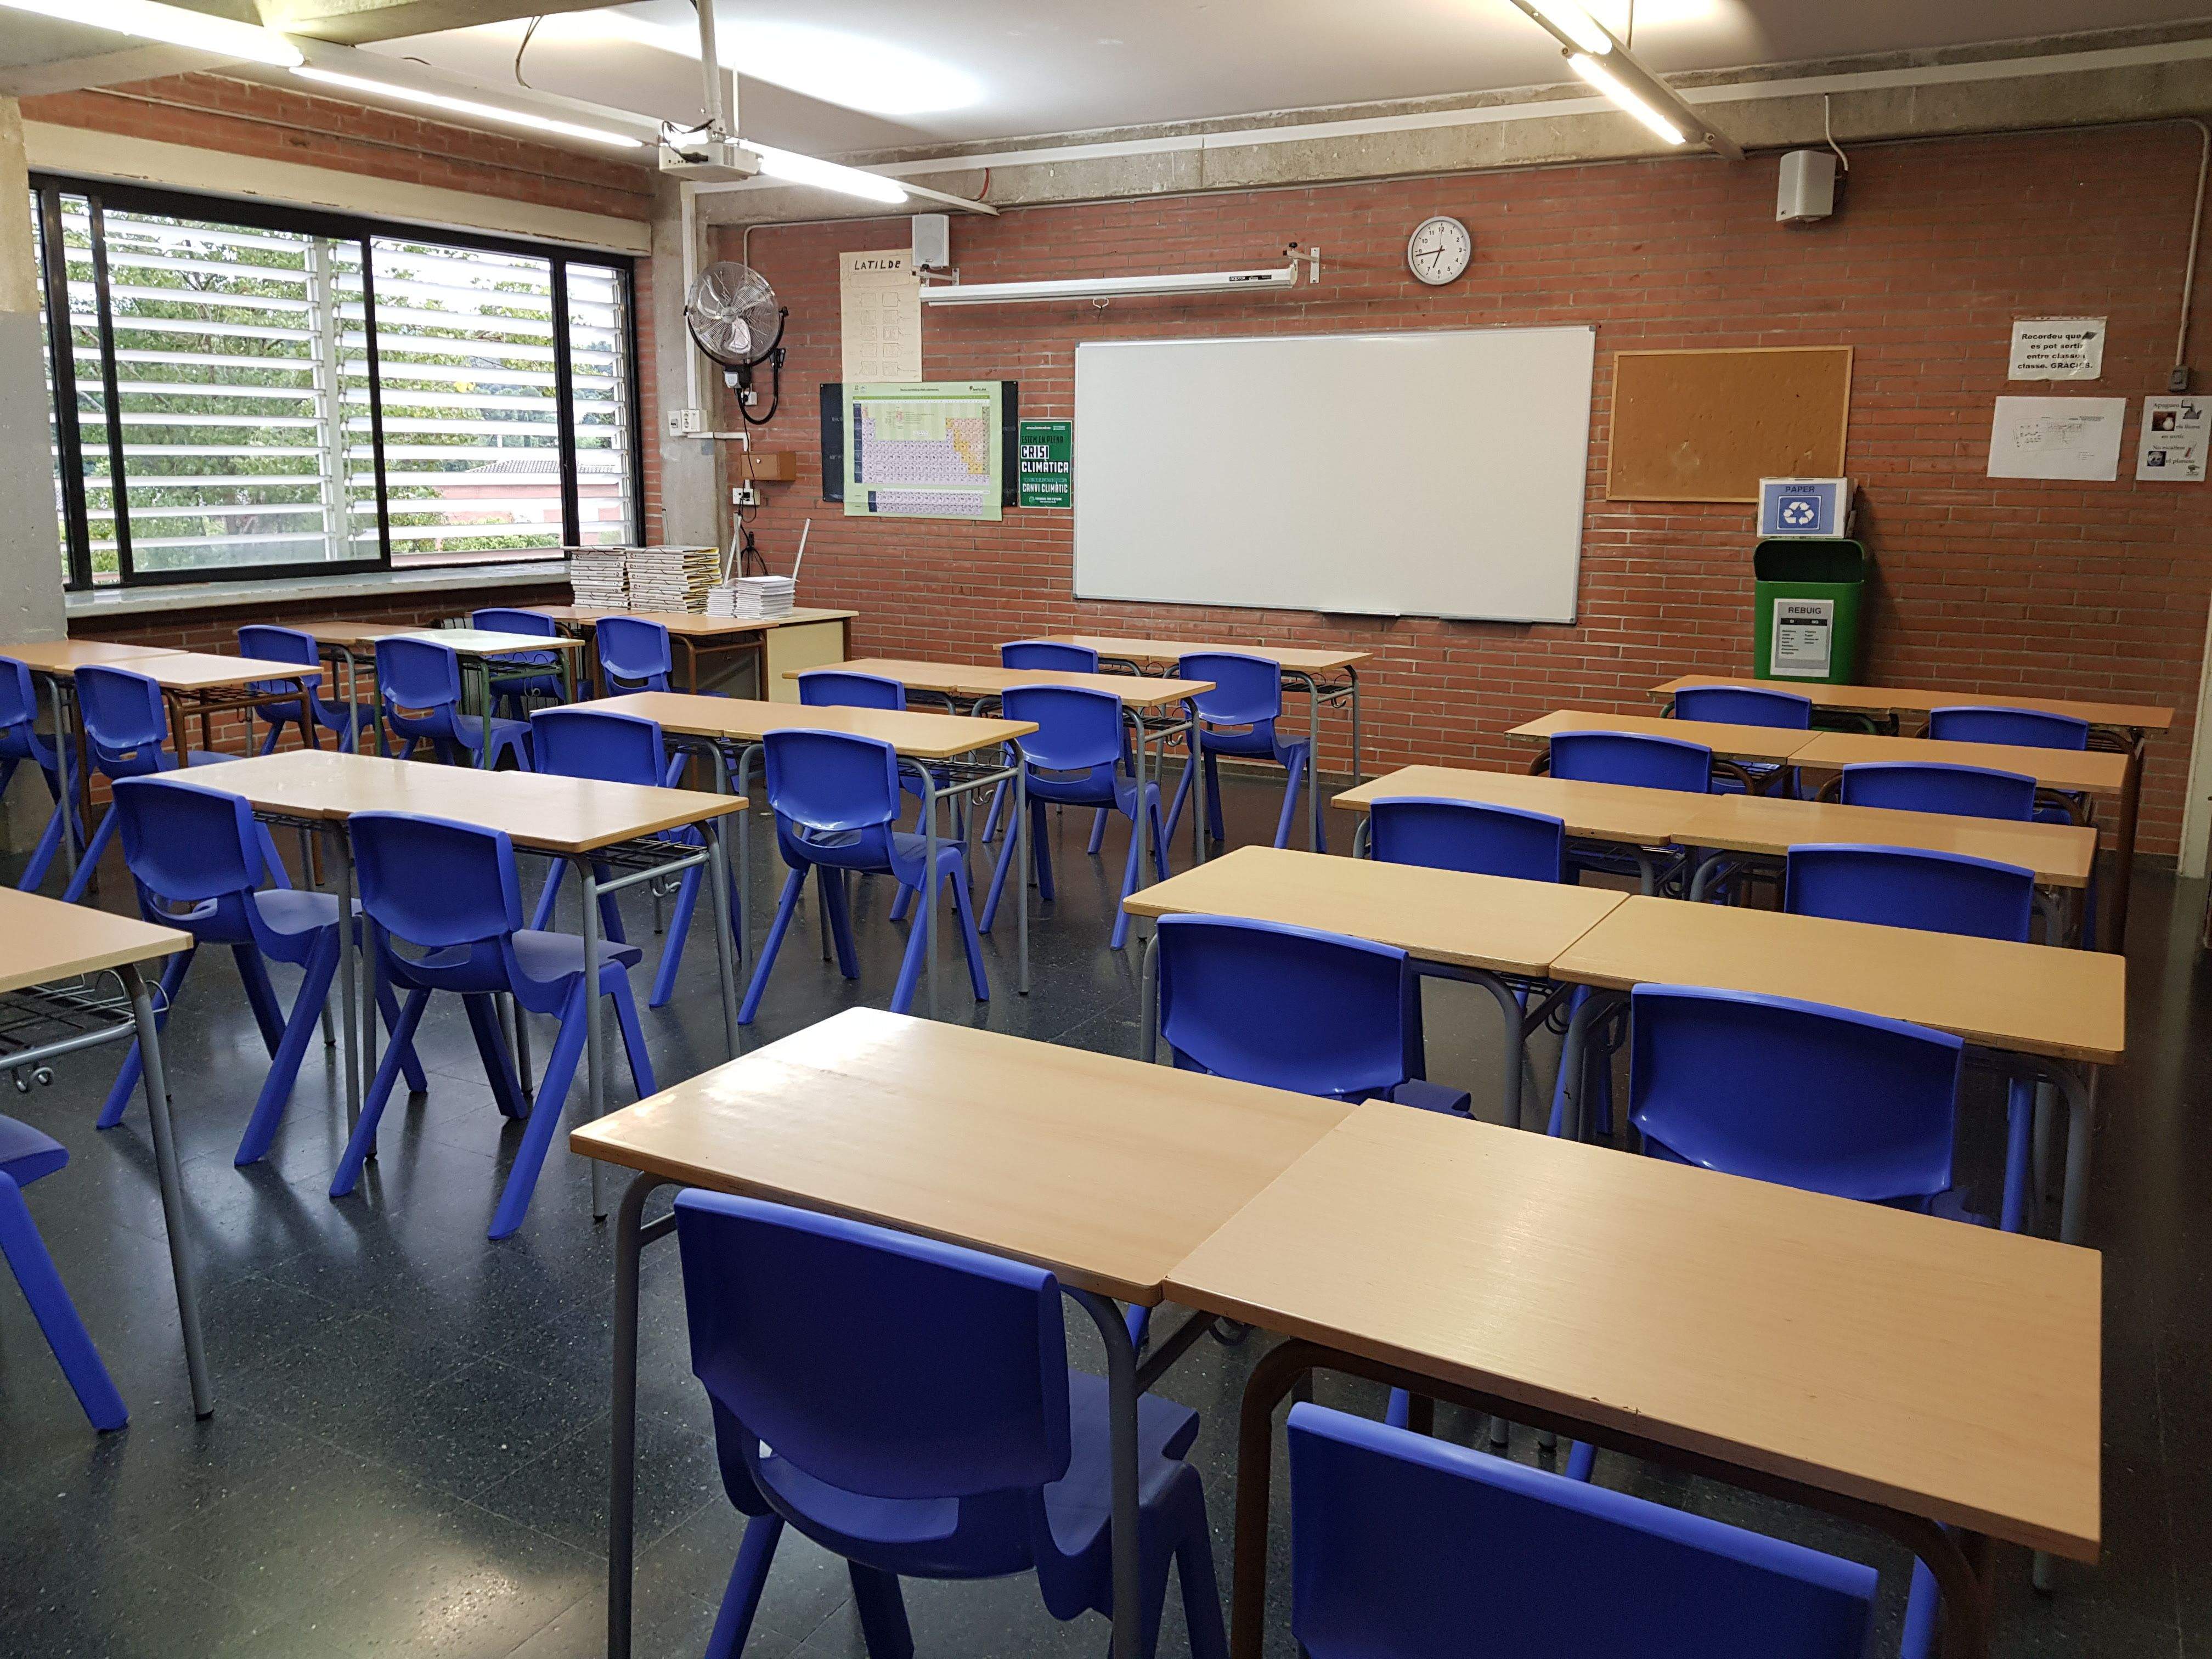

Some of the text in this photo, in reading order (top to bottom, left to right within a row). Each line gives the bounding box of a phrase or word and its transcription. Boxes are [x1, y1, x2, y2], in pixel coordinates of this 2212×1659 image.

[1022, 446, 1048, 458] CRISI
[1022, 459, 1069, 473] CLIMÀTICA
[1022, 482, 1068, 493] CANVI CLIMÀTIC
[1785, 486, 1815, 494] PAPER
